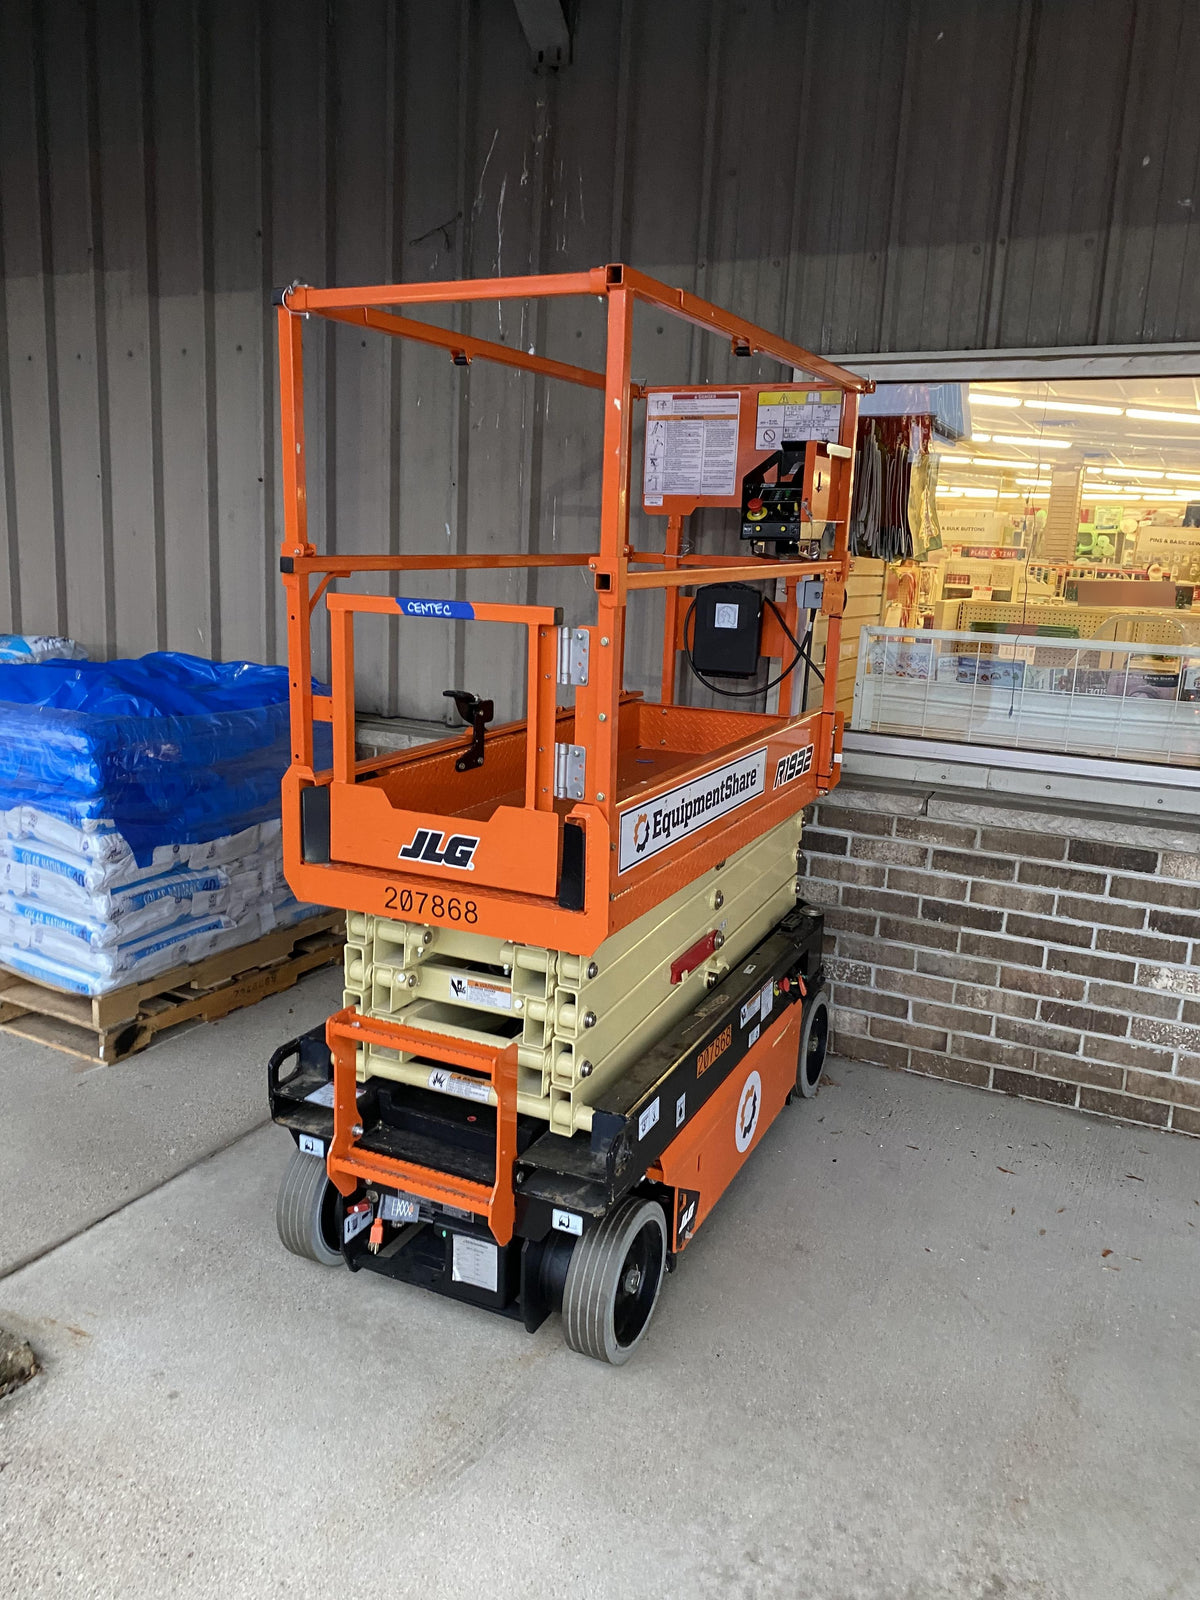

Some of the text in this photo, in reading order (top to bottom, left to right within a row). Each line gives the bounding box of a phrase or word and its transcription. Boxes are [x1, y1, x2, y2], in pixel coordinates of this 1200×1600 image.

[990, 548, 998, 558] &
[999, 548, 1016, 558] TIME
[407, 601, 452, 616] CENTEC
[773, 743, 814, 791] R1932
[652, 767, 758, 840] EquipmentShare
[398, 828, 480, 870] JLG
[73, 870, 86, 888] 40
[202, 878, 218, 892] 40
[384, 886, 479, 925] 207868
[698, 1026, 732, 1077] 207868
